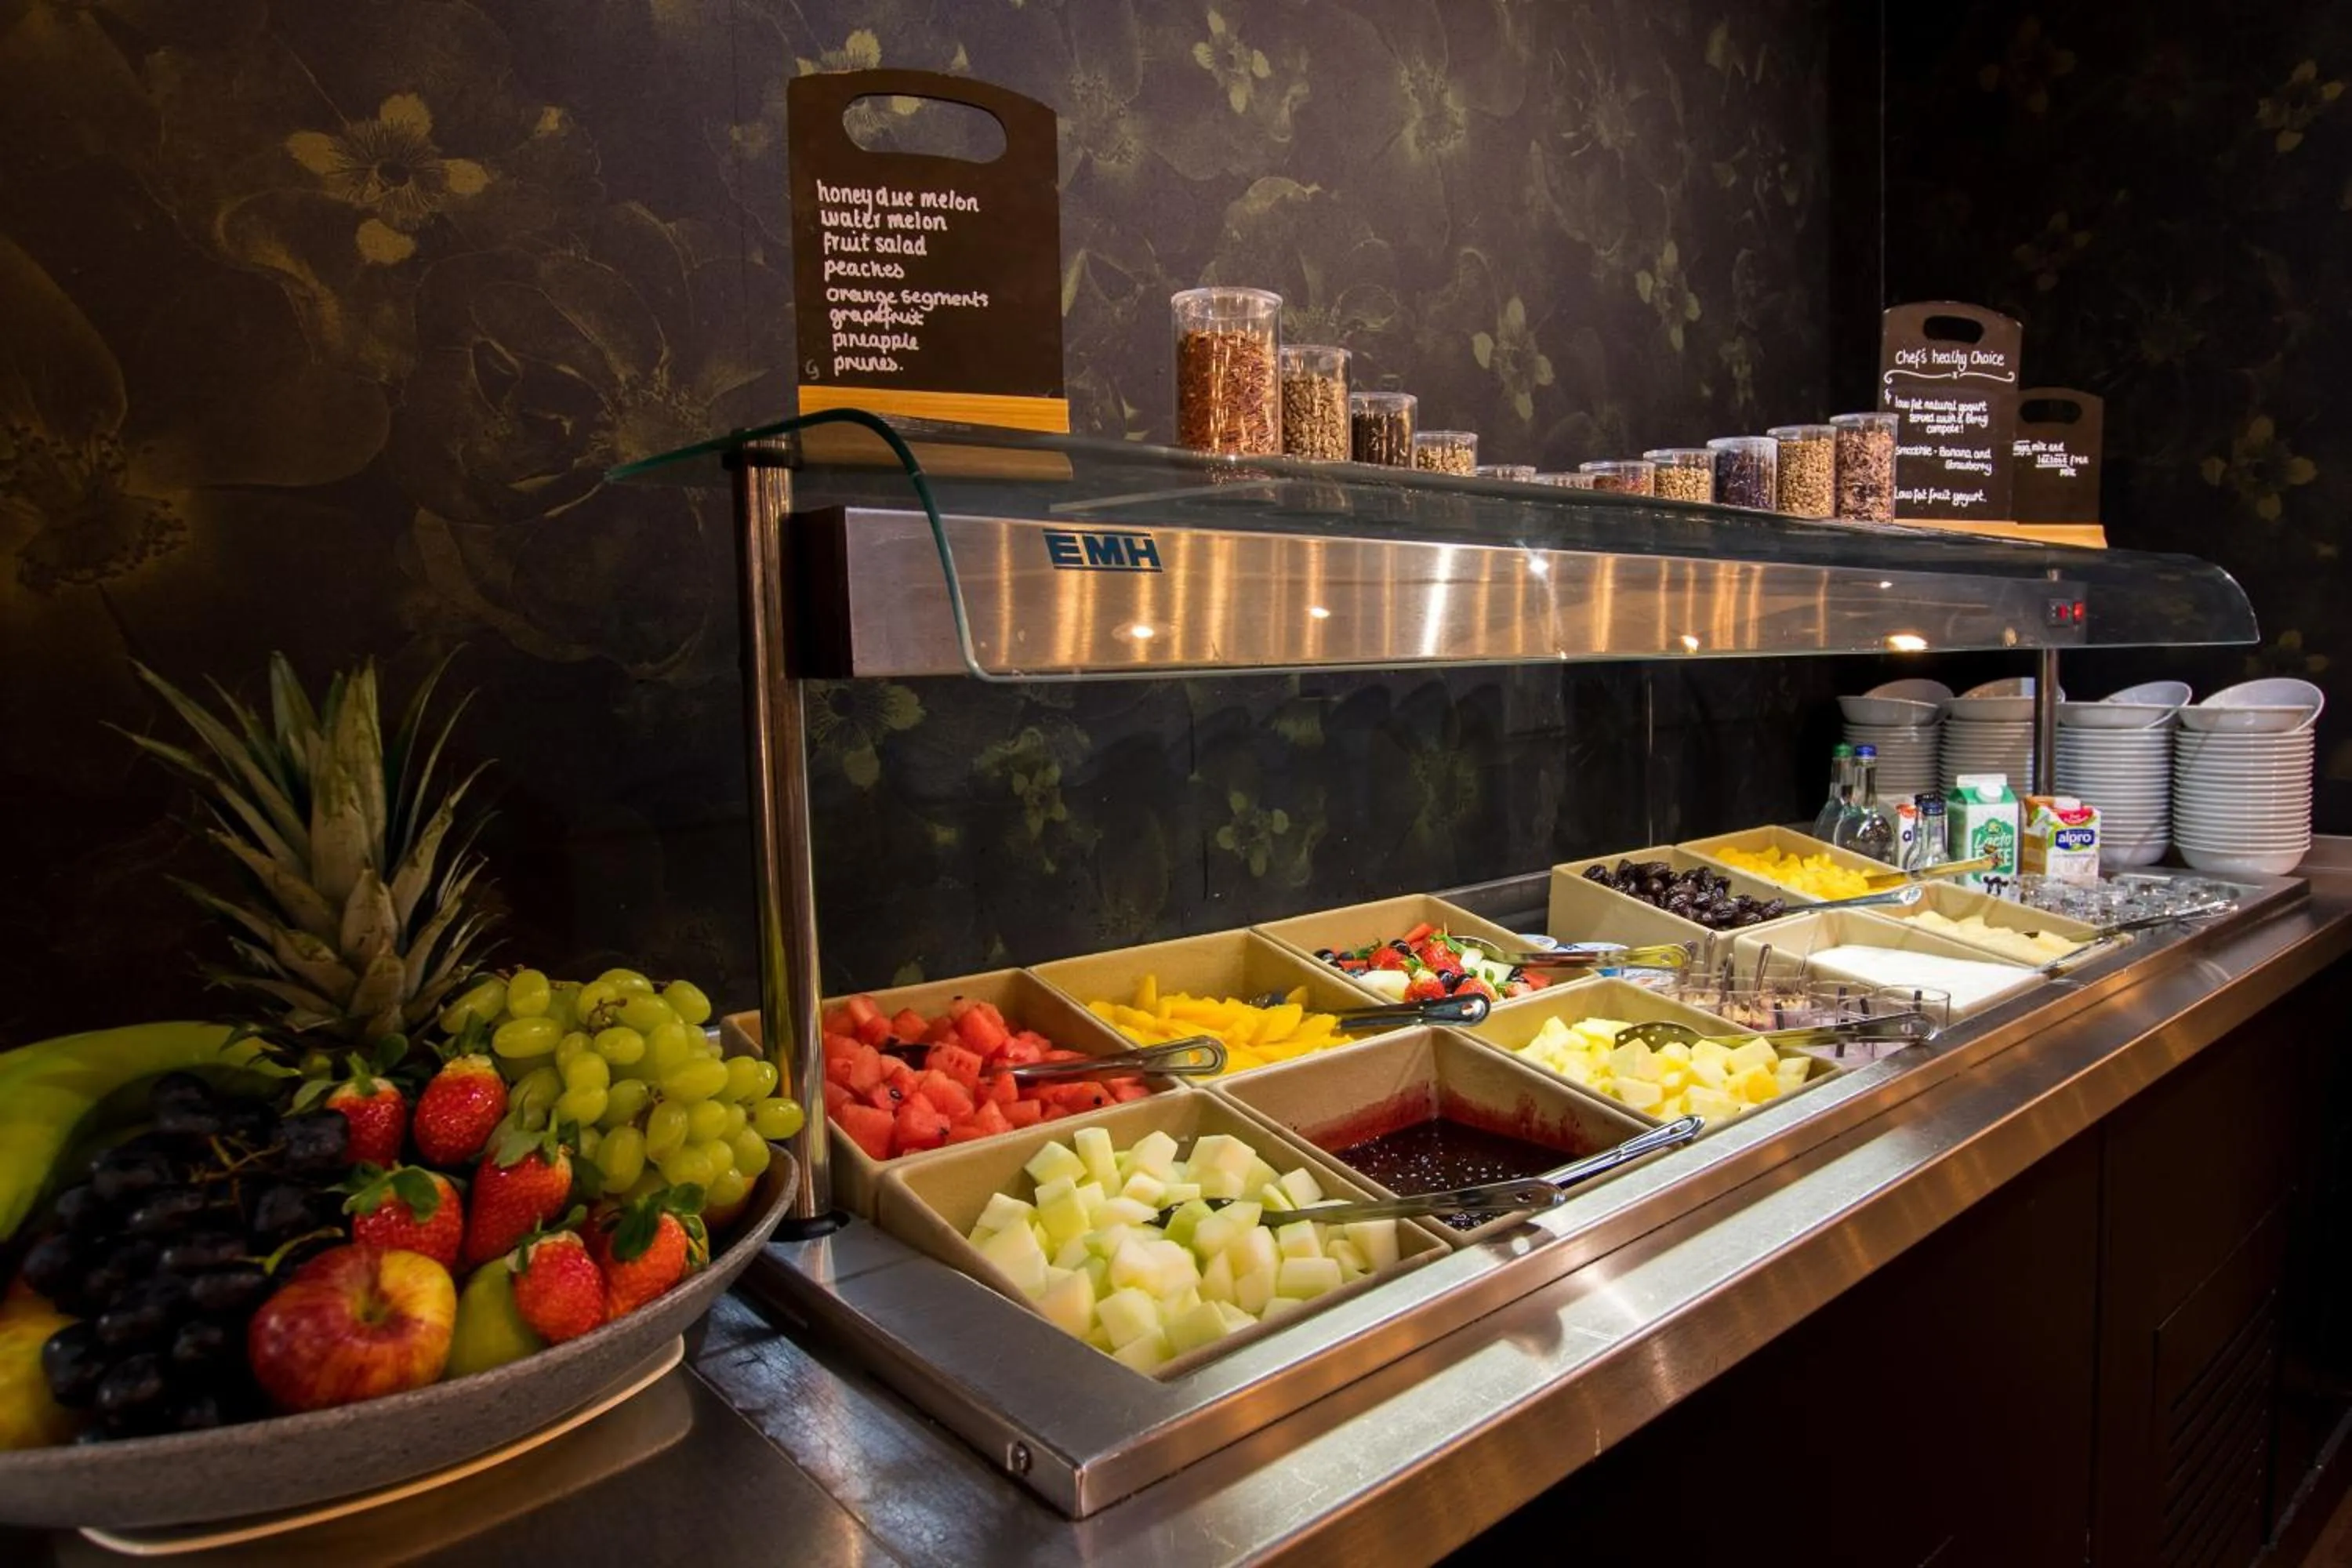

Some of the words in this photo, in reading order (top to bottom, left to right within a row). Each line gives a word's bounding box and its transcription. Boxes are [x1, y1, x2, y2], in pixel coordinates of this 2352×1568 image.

[920, 190, 979, 212] melon
[821, 209, 880, 229] water
[887, 211, 948, 231] melon
[875, 234, 927, 256] salad
[824, 259, 905, 281] peaches
[826, 288, 898, 310] orange
[901, 289, 989, 311] segments
[829, 308, 924, 330] grapefruit
[833, 332, 919, 354] pineapple
[1895, 347, 1928, 369] Chef's
[1914, 488, 1928, 504] fat
[1928, 487, 1951, 504] fruit
[1044, 534, 1163, 568] EMH
[2058, 831, 2092, 846] alpro
